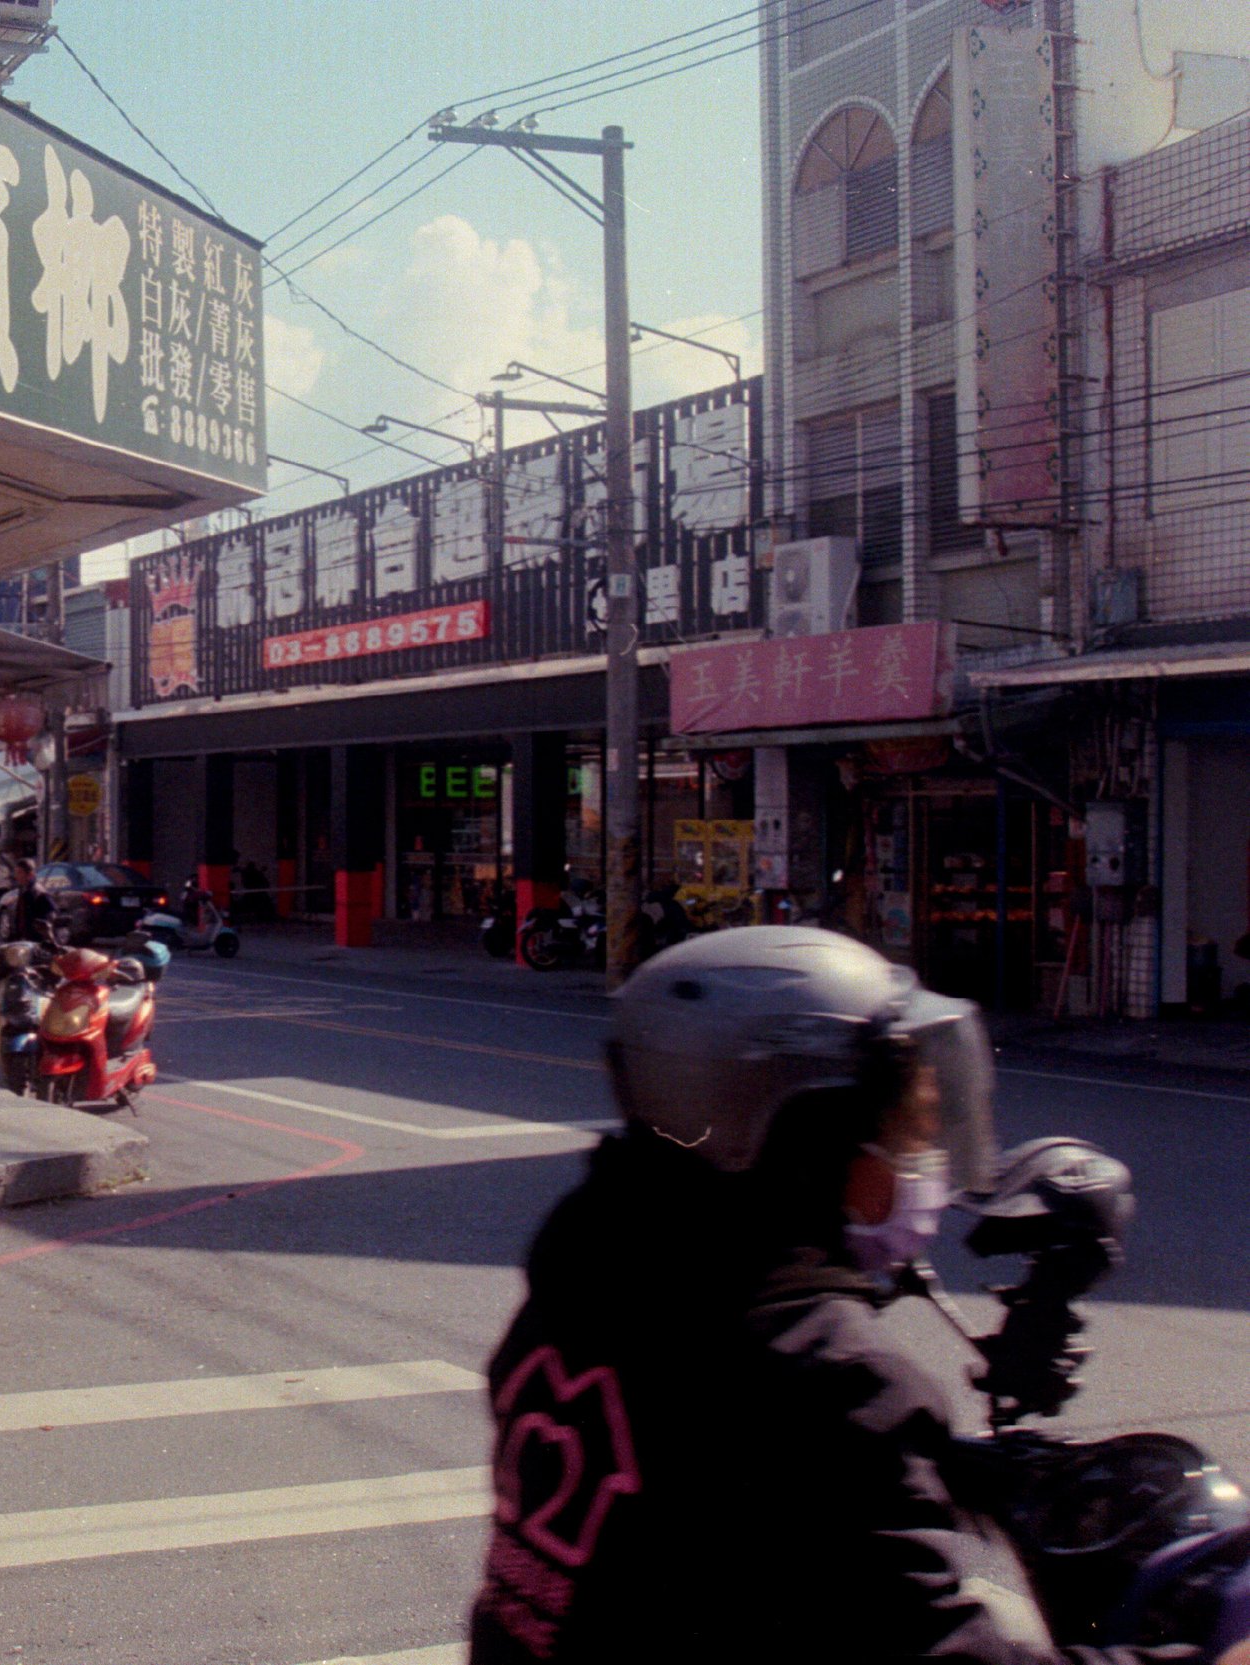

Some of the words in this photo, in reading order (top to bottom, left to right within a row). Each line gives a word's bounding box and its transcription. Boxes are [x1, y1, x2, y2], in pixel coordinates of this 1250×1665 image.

[138, 200, 255, 310] 特製紅灰
[139, 327, 256, 427] 批發/零售
[268, 609, 479, 665] 03-8889575
